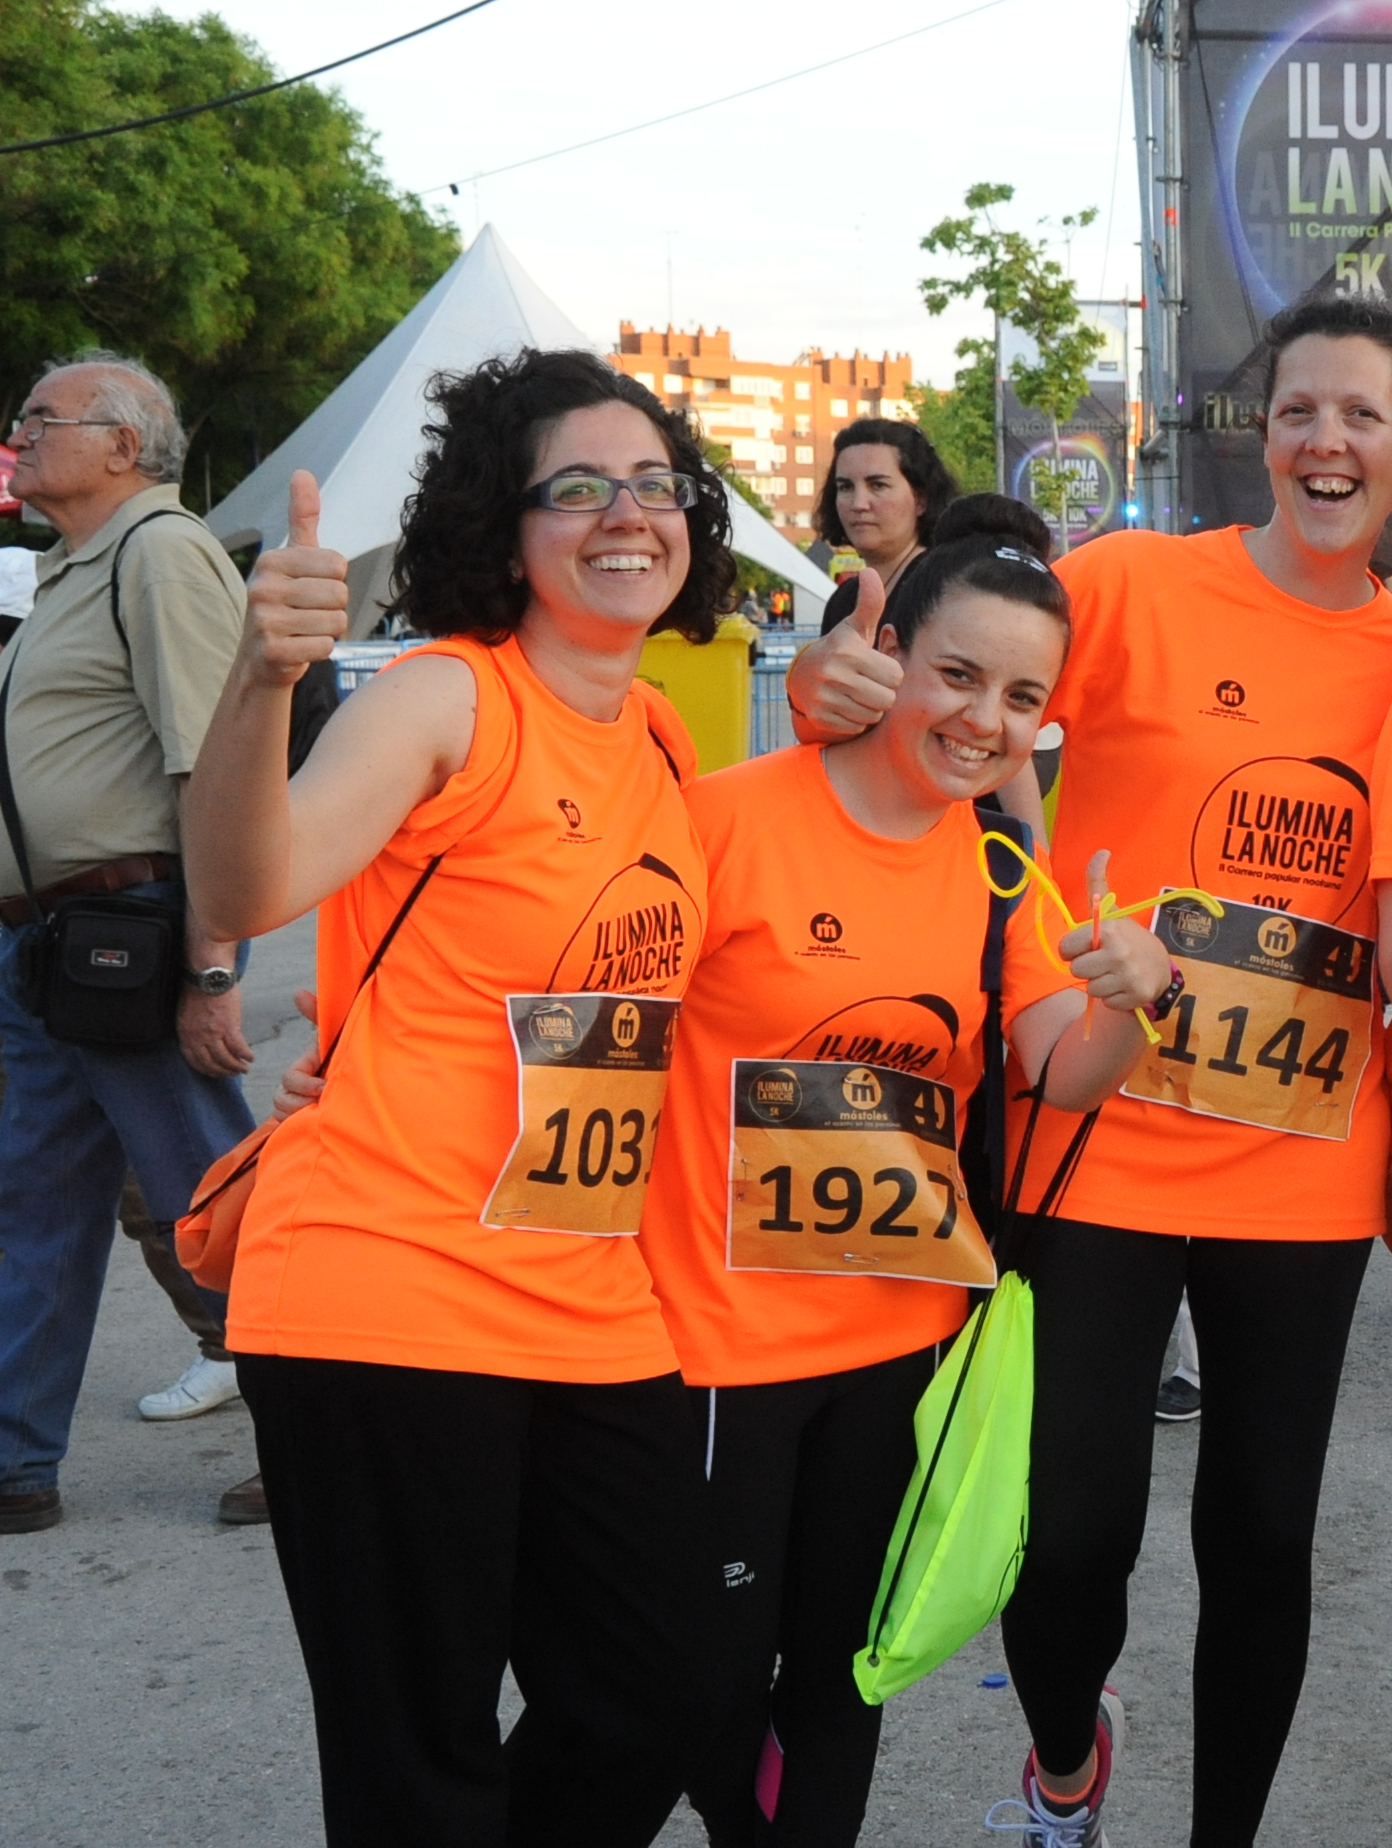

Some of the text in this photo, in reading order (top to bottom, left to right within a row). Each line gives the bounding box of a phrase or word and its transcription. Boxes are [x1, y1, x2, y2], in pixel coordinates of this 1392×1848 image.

[1306, 221, 1379, 239] Carrera
[1335, 253, 1389, 301] 5K
[1227, 789, 1353, 844] ILUMINA
[1227, 865, 1263, 878] Carrera
[1264, 870, 1301, 884] popular
[593, 901, 684, 961] ILUMINA
[1249, 953, 1295, 972] móstoles
[816, 1034, 939, 1069] ILUMINA
[1157, 994, 1349, 1094] 1144
[757, 1081, 794, 1092] ILUMINA
[839, 1110, 888, 1121] móstoles
[759, 1165, 958, 1240] 1927
